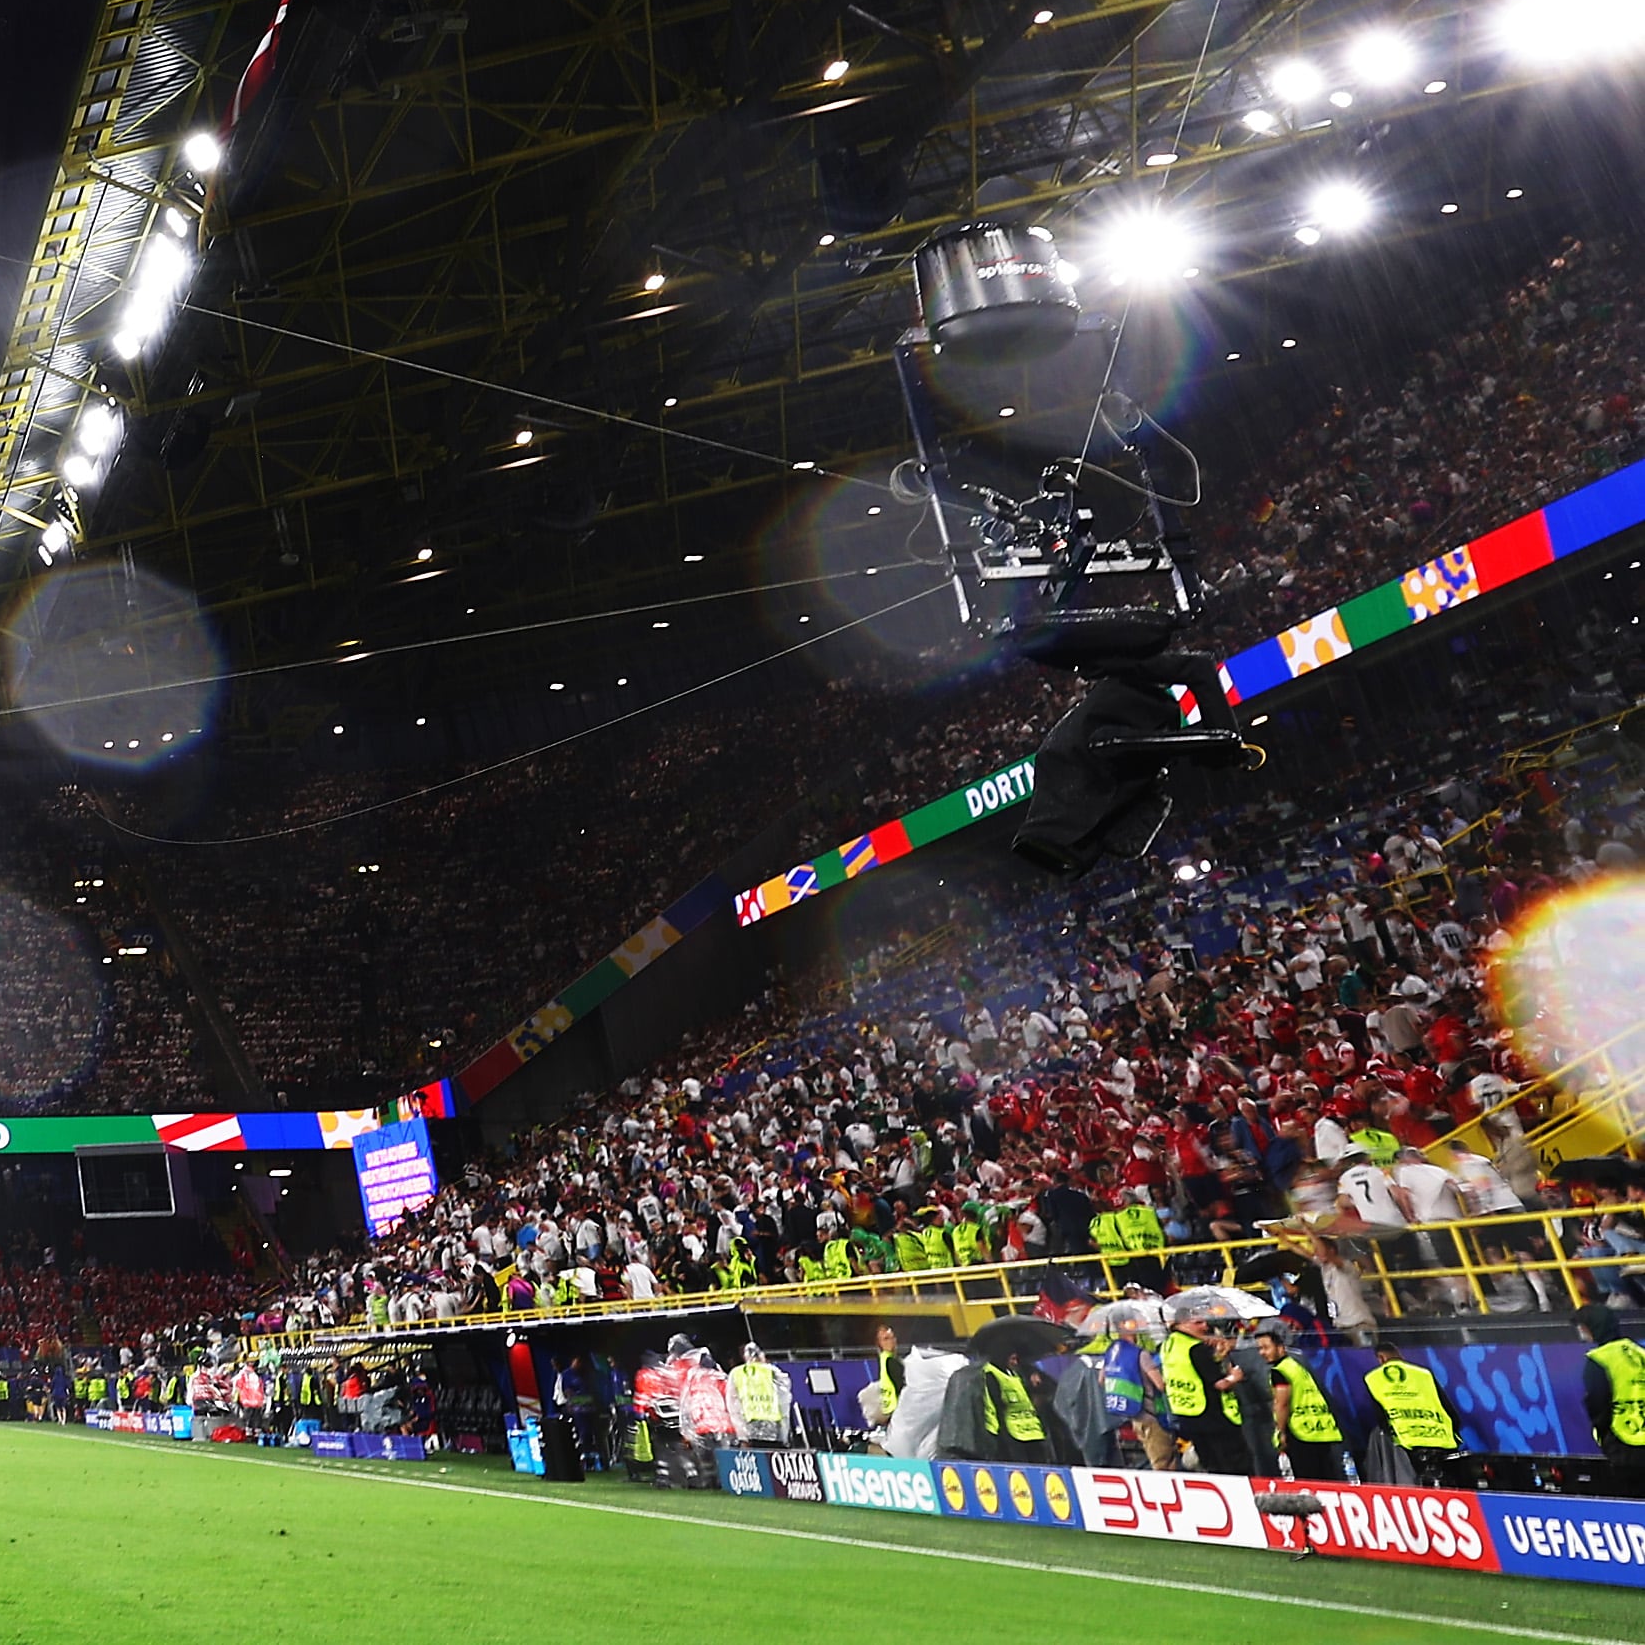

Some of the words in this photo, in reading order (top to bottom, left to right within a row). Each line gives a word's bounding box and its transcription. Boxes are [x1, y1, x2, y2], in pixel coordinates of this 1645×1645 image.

[1356, 1180, 1373, 1203] 7
[772, 1451, 818, 1486] QATAR
[822, 1454, 934, 1511] Hisense
[1093, 1474, 1234, 1538] BYD
